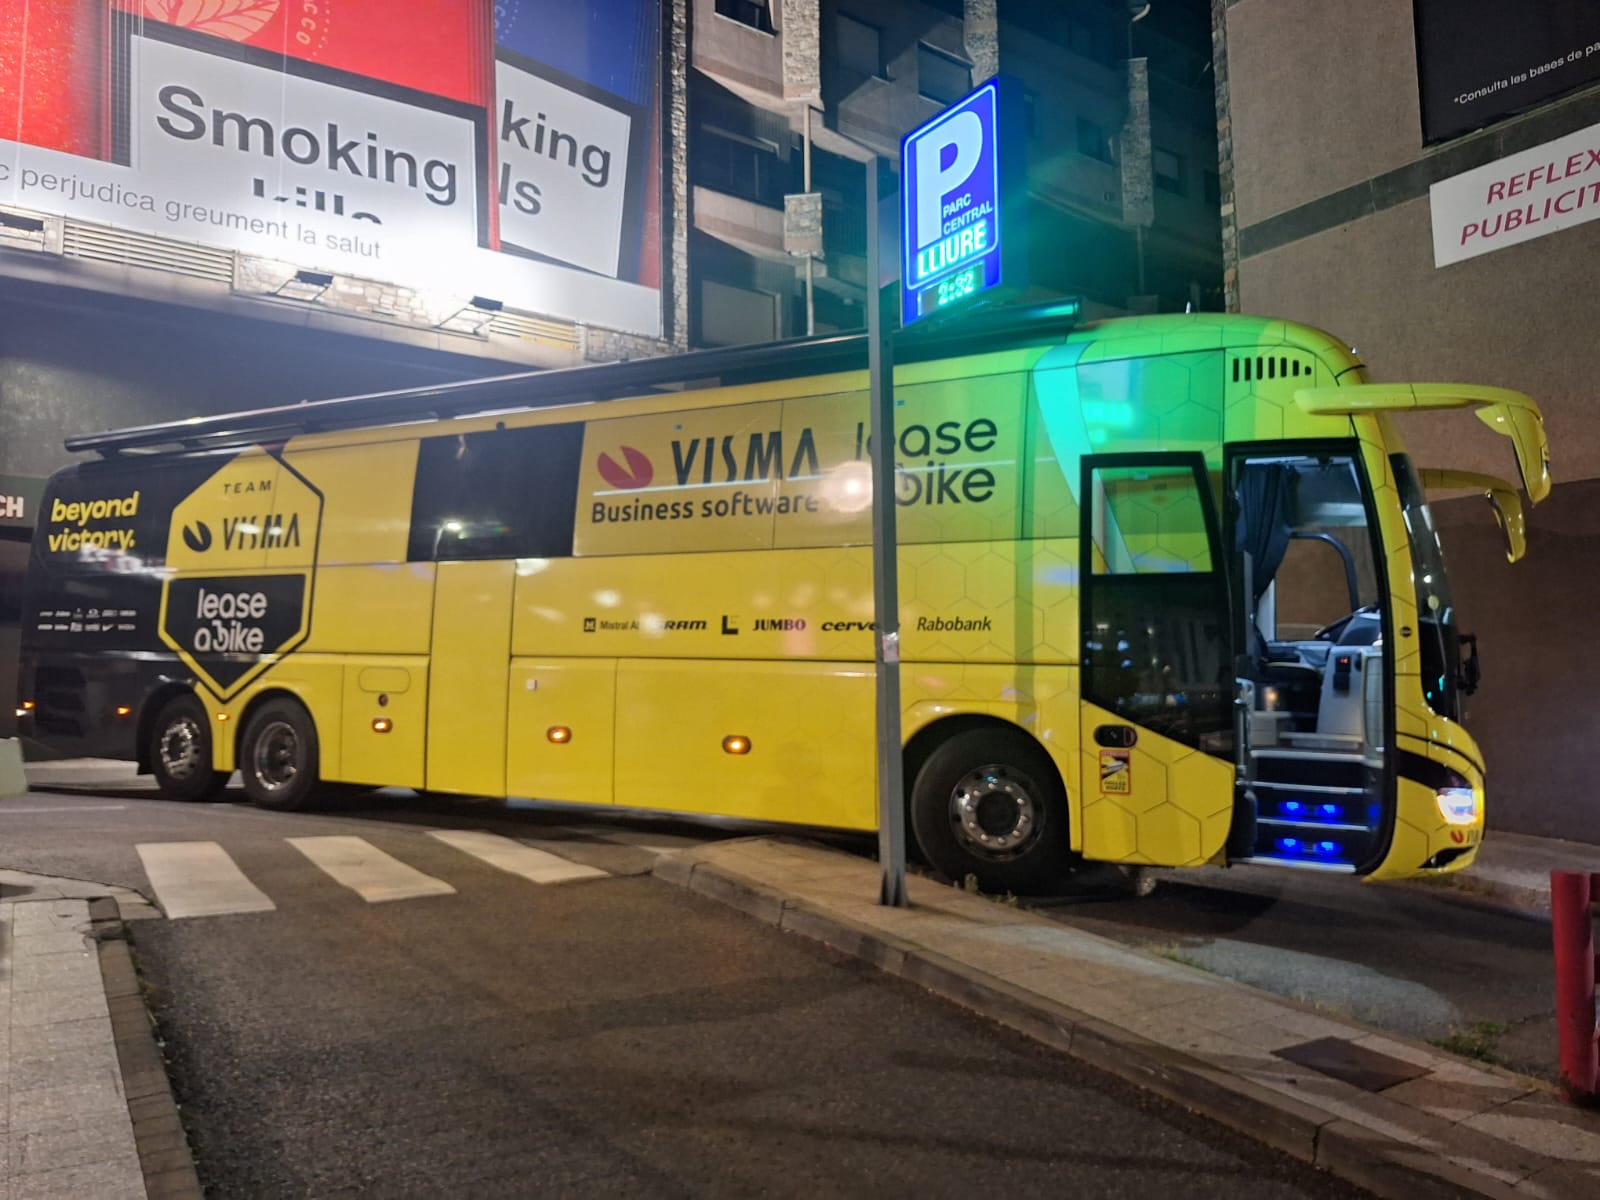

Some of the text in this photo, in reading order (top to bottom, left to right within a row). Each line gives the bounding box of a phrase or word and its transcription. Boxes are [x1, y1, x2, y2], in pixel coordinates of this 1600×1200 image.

[1529, 57, 1564, 78] bases
[1567, 50, 1582, 62] de
[156, 85, 456, 206] Smoking
[501, 99, 611, 188] king
[916, 111, 983, 249] P
[1487, 149, 1600, 205] REFLEX
[21, 168, 155, 213] perjudica
[165, 199, 288, 239] greument
[297, 223, 316, 245] la
[326, 236, 382, 259] salut
[943, 193, 972, 218] PARC
[943, 201, 994, 235] CENTRAL
[917, 218, 988, 279] LLIURE
[938, 271, 974, 306] 2:32
[670, 418, 998, 487] VISMA lase
[223, 480, 272, 494] TEAM
[51, 490, 140, 526] beyond
[592, 491, 819, 523] Business software
[48, 527, 136, 554] victory.
[223, 512, 301, 551] VISMA
[197, 588, 267, 619] lease
[600, 620, 628, 630] Mistral
[658, 620, 707, 631] RAM
[752, 618, 806, 631] JUMBO
[821, 619, 899, 632] cerve
[916, 616, 992, 632] Rabobank
